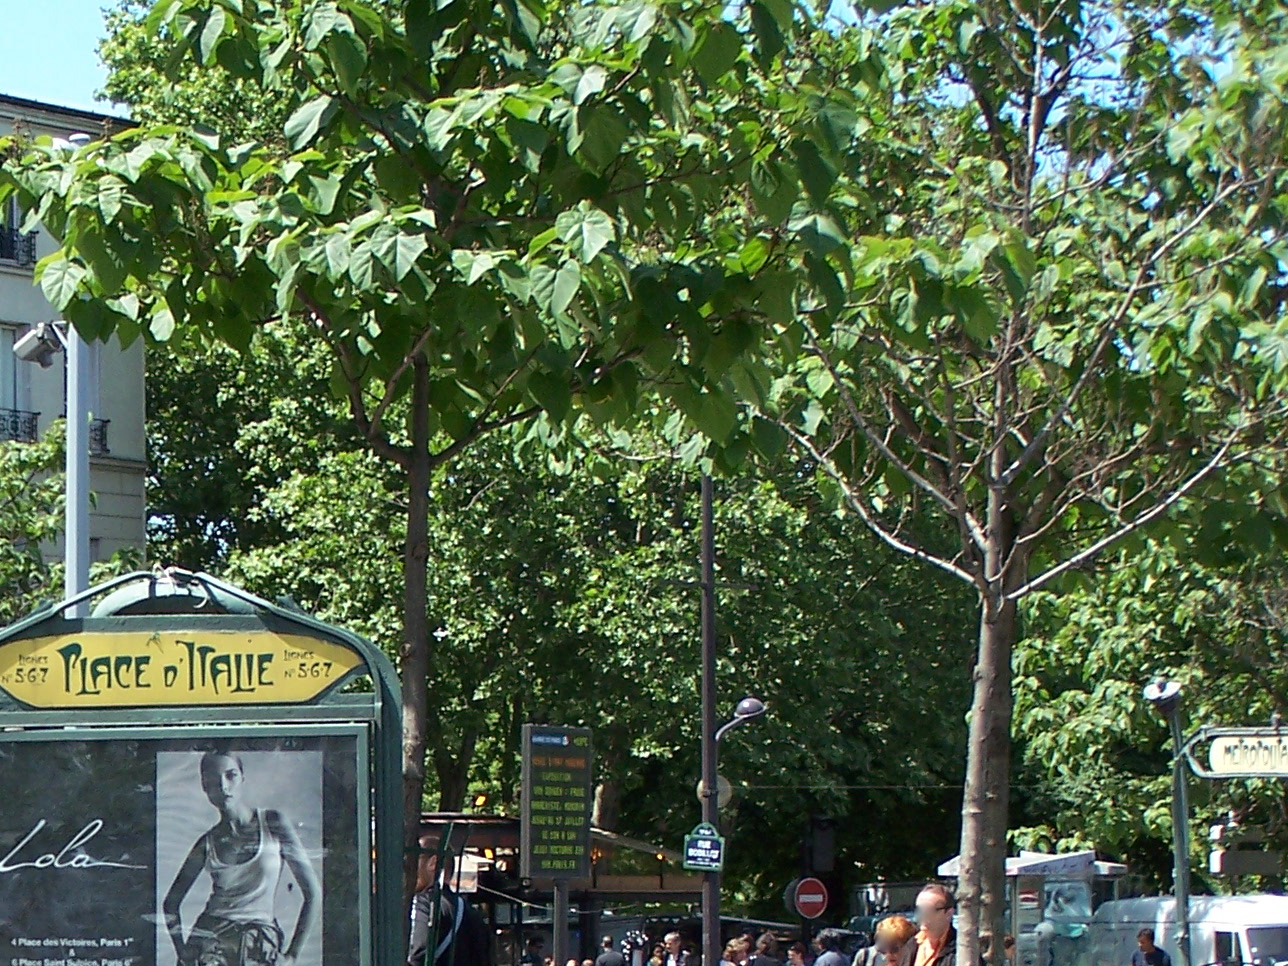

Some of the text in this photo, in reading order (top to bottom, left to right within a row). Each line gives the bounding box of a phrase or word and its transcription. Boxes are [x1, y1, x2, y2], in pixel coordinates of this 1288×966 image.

[56, 643, 152, 695] PLACE
[18, 938, 41, 947] Place
[43, 938, 59, 947] des
[100, 938, 123, 947] Paris
